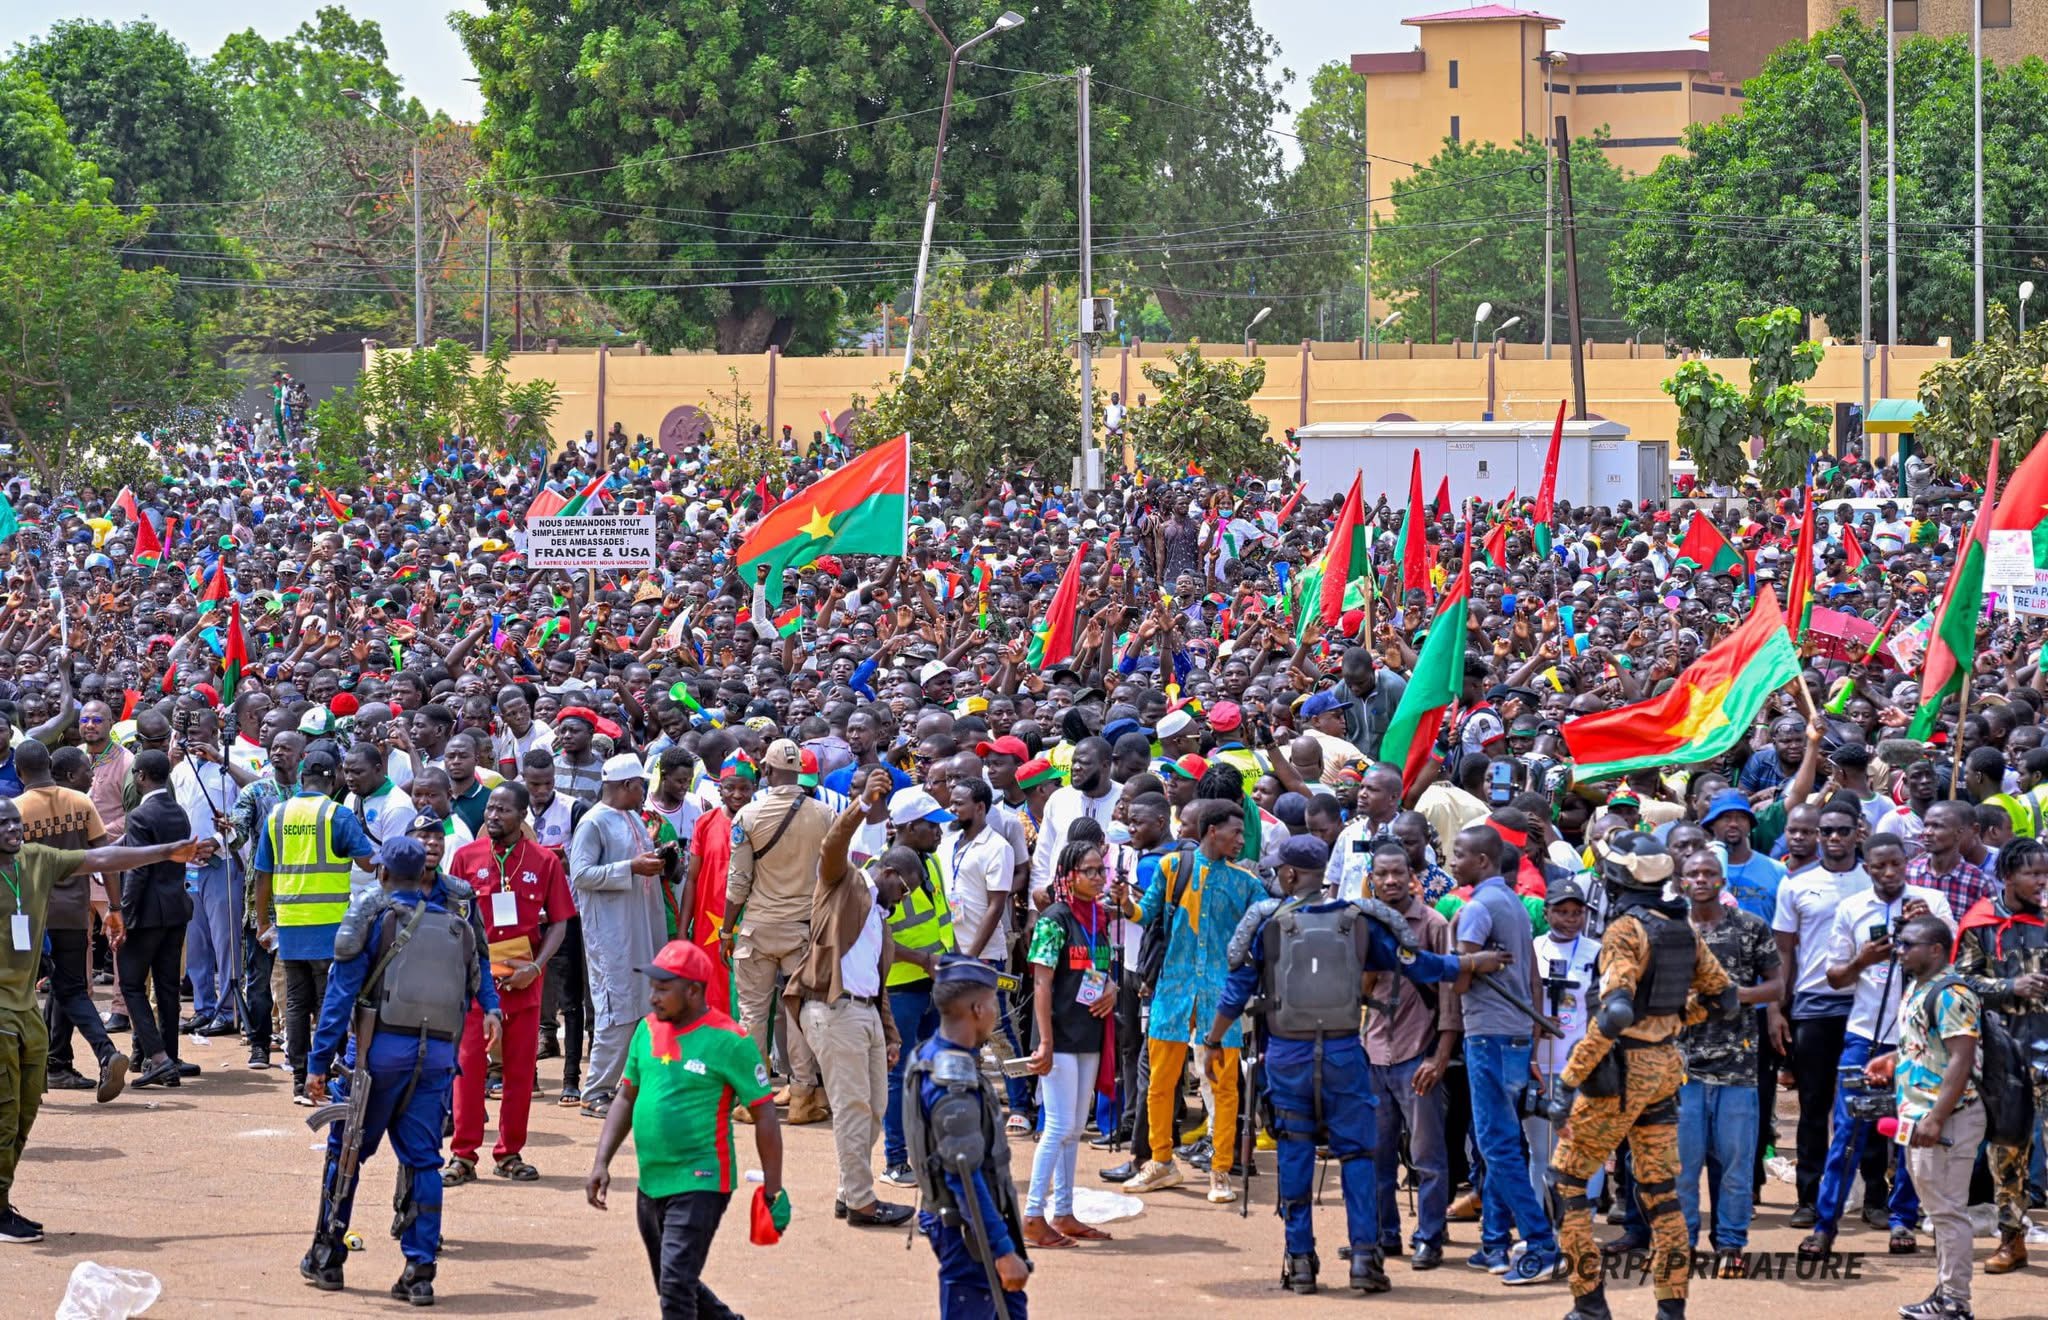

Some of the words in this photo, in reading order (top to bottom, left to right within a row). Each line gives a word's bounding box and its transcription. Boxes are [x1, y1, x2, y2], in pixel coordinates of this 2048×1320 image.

[539, 519, 562, 527] NOUS
[565, 519, 617, 527] DEMANDONS
[532, 529, 585, 537] SIMPLEMENT
[600, 528, 649, 536] FERMETURE
[551, 538, 567, 546] DES
[570, 538, 625, 546] AMBASSADES
[535, 548, 597, 557] FRANCE
[602, 547, 613, 557] &
[619, 547, 650, 557] USA
[522, 871, 538, 884] 24
